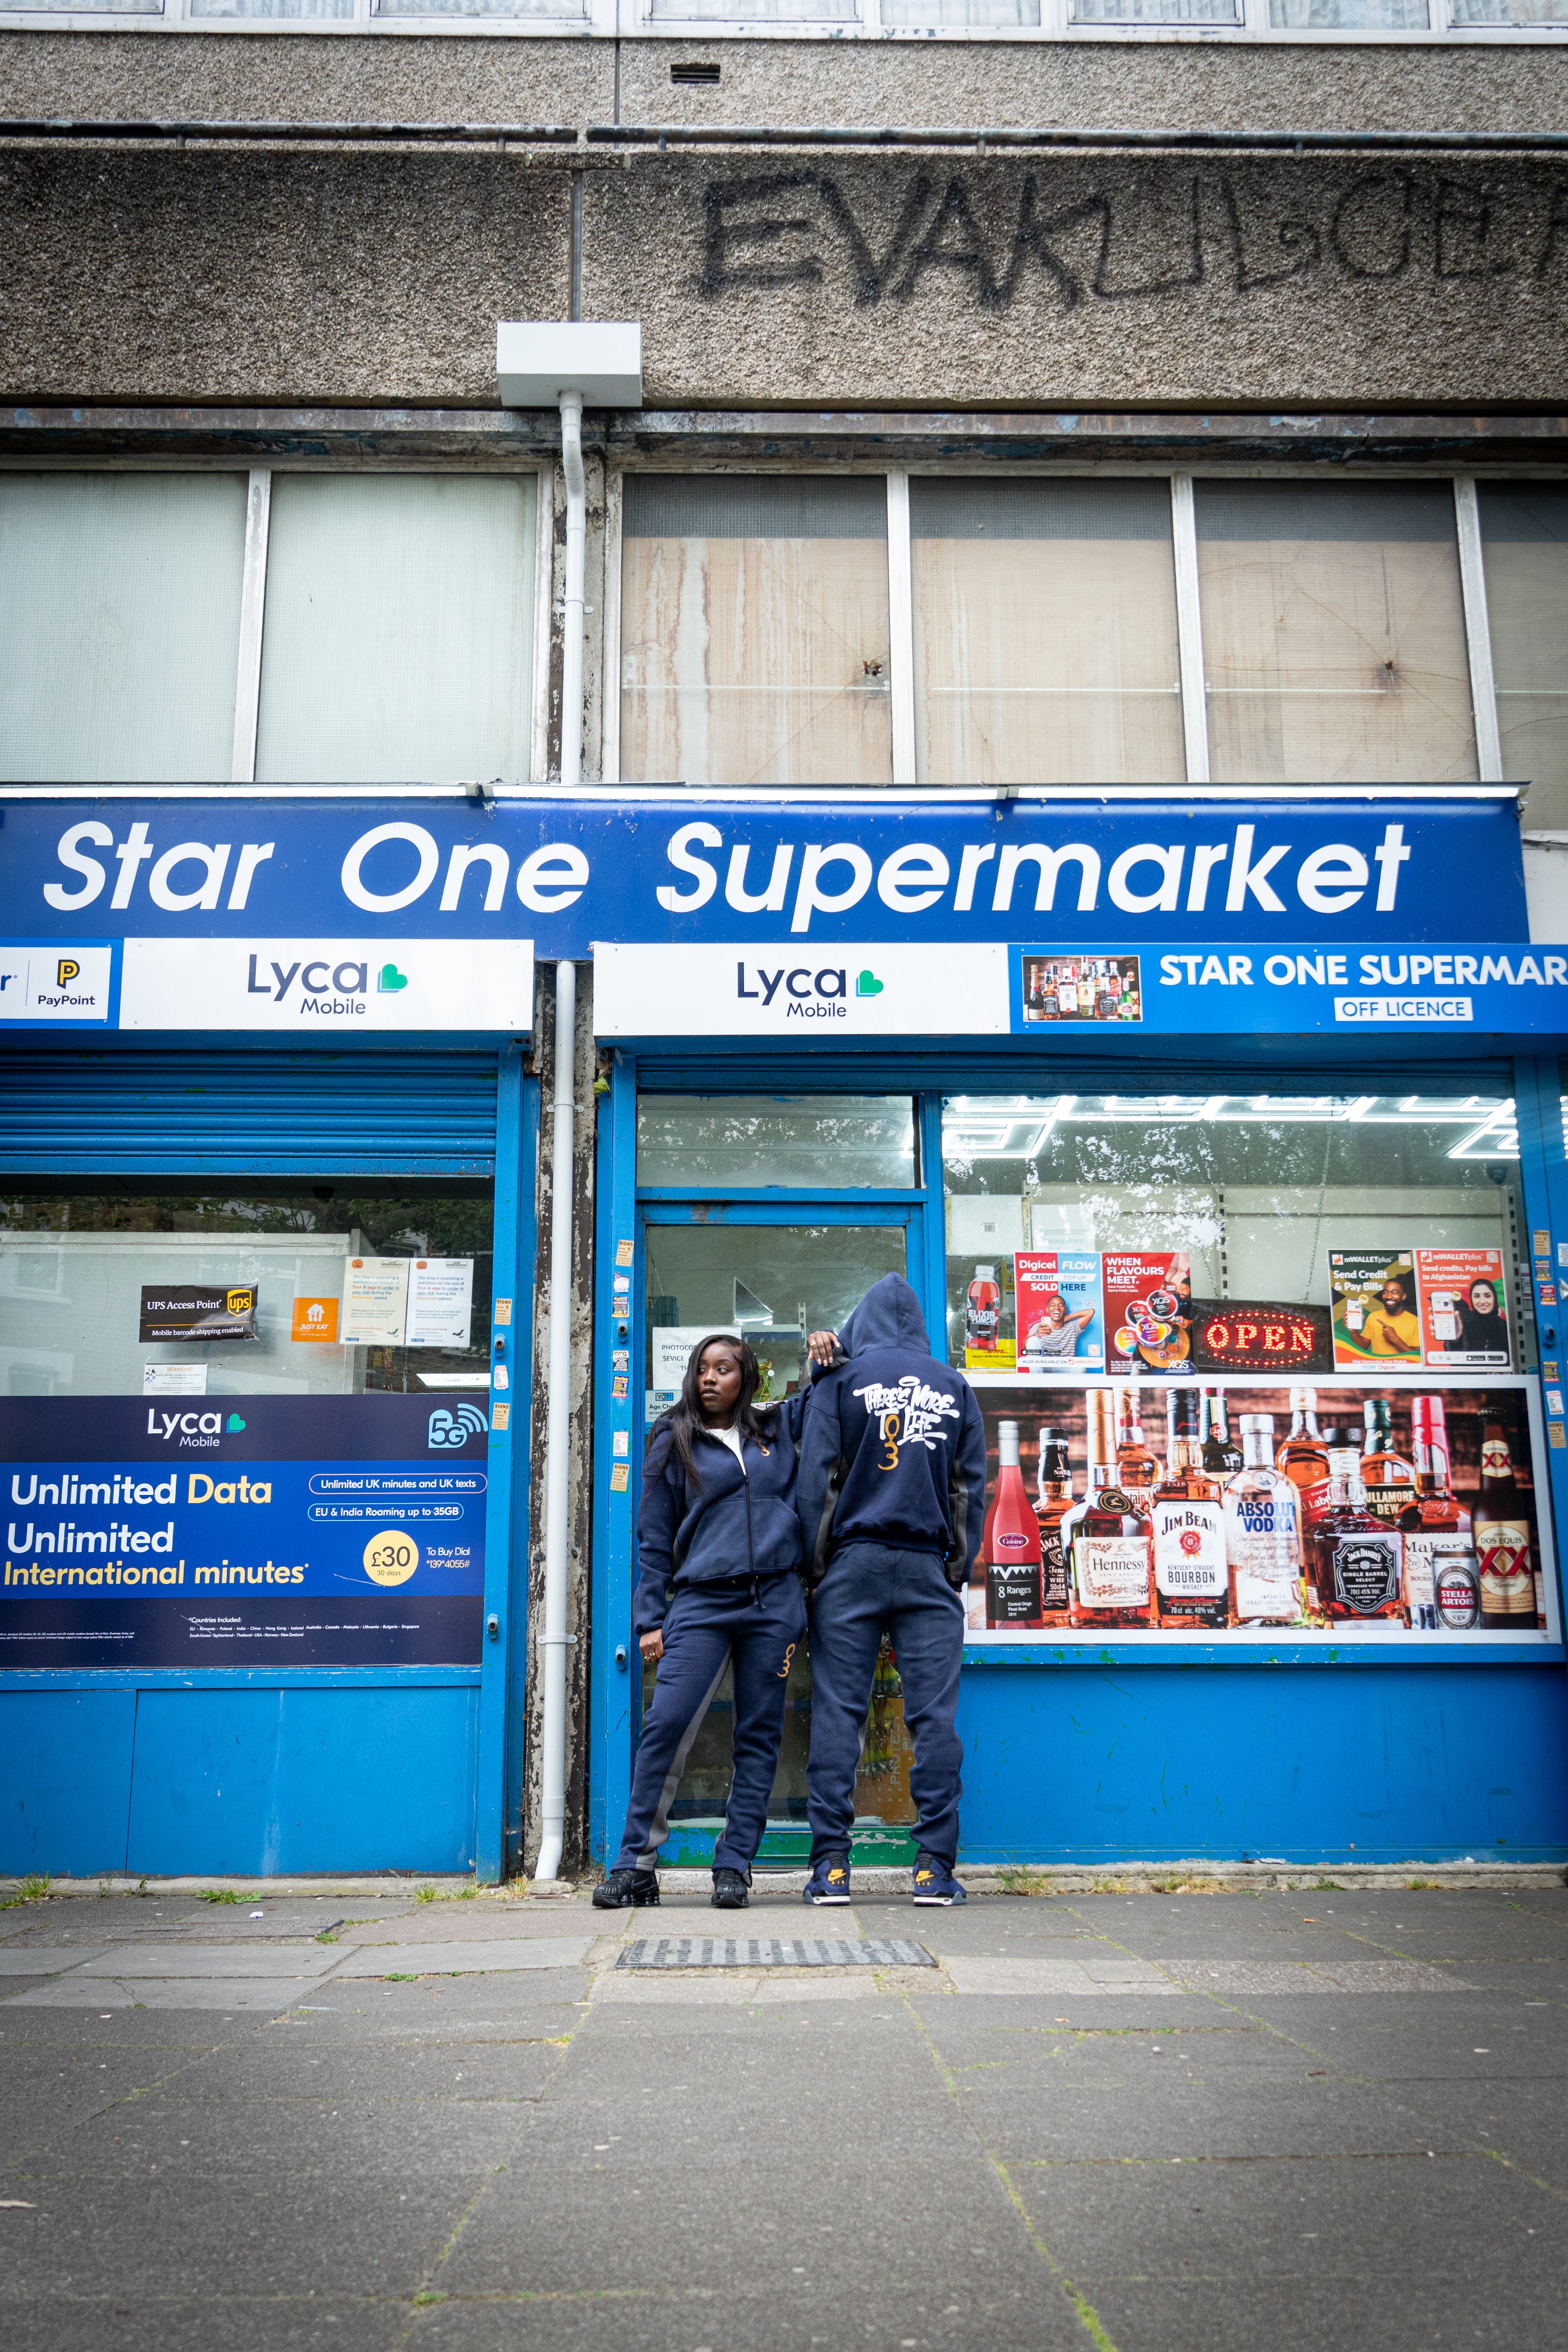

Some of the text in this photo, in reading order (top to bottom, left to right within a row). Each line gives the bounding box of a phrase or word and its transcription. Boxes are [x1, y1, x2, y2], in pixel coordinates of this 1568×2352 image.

[44, 821, 1412, 932] Star One Supermarket
[1159, 955, 1568, 985] STAR ONE SUPERMAR
[248, 954, 367, 1002] Lyca
[738, 962, 847, 1002] Lyca
[38, 995, 95, 1007] PayPoint
[300, 998, 366, 1015] Mobile
[787, 1003, 847, 1018] Mobile
[1342, 1001, 1465, 1017] OFF LICENCE
[1019, 1260, 1056, 1271] Digicel
[1062, 1261, 1097, 1270] FLOW
[1106, 1258, 1141, 1266] WHEN
[1107, 1267, 1164, 1275] FLAVOURS
[1333, 1270, 1387, 1279] Send Credit
[1031, 1283, 1058, 1291] SOLD
[1334, 1282, 1384, 1292] & Pay Bills
[147, 1301, 165, 1310] UPS
[196, 1301, 220, 1309] Point
[229, 1298, 249, 1313] ups
[1206, 1324, 1314, 1351] OPEN
[1167, 1360, 1189, 1369] XQS
[148, 1409, 221, 1439] Lyca
[430, 1418, 464, 1446] 5G
[179, 1437, 220, 1447] Mobile
[11, 1474, 272, 1505] Unlimited Data
[321, 1479, 476, 1489] Unlimited UK minutes and UK texts
[315, 1508, 328, 1516] EU
[331, 1508, 337, 1516] &
[341, 1508, 363, 1516] India
[366, 1508, 405, 1518] Roaming
[408, 1509, 419, 1518] up
[434, 1507, 459, 1516] 35GB
[1237, 1502, 1295, 1517] ABSOLUT
[1377, 1504, 1399, 1515] DEW
[1162, 1511, 1217, 1536] JIM BEAM
[1243, 1518, 1292, 1532] VODKA
[8, 1522, 174, 1553] Unlimited
[372, 1546, 410, 1567] £30
[426, 1547, 470, 1557] To Buy Dial
[1347, 1548, 1382, 1562] JACK DANIEL'S
[1093, 1558, 1145, 1572] Hennessy
[4, 1560, 184, 1585] International
[1169, 1572, 1215, 1583] BOURBON
[998, 1586, 1031, 1598] 8 Ranges
